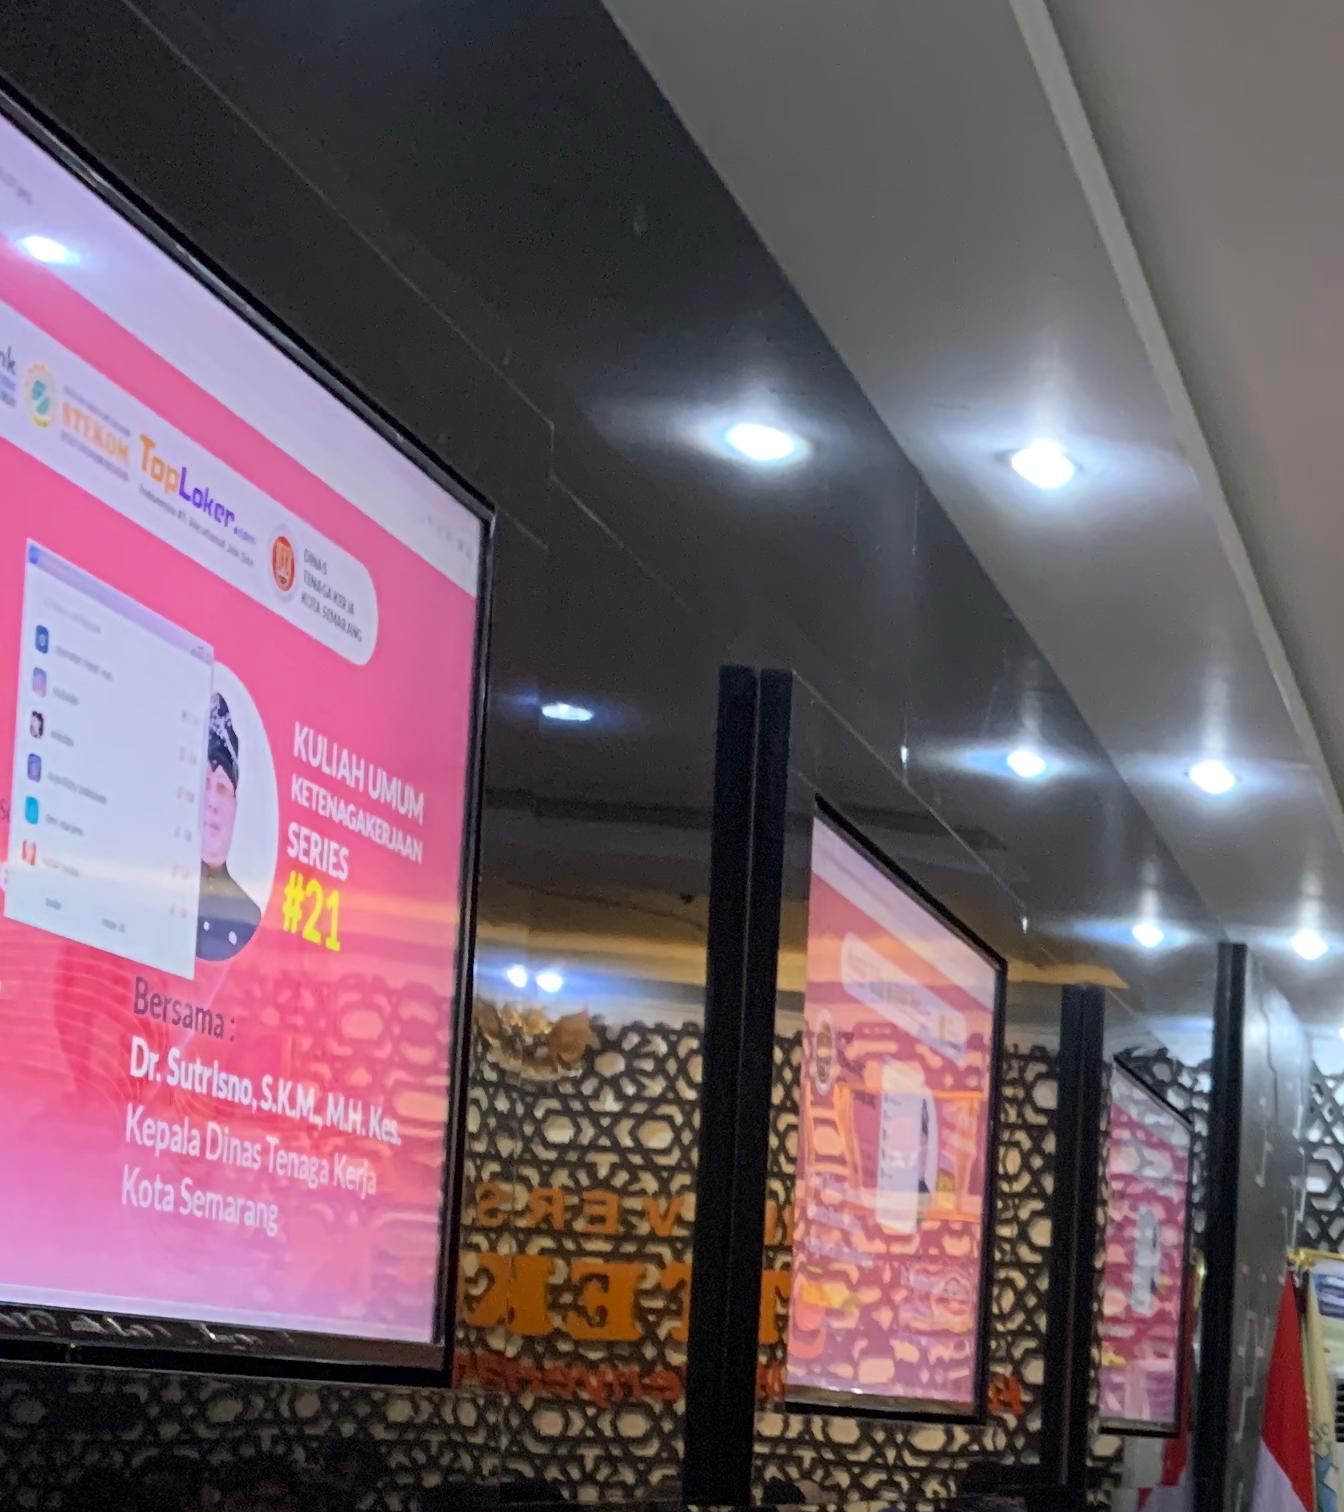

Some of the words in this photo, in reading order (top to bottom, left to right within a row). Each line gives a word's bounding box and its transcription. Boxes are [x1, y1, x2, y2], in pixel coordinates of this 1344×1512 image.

[293, 721, 365, 793] KULIAH
[368, 763, 424, 825] UMUM
[287, 821, 350, 882] SERIES
[291, 773, 424, 865] KETENAGAKERJAAN
[282, 870, 342, 953] #21
[133, 976, 225, 1040] Bersama
[129, 1035, 162, 1082] Dr.
[166, 1047, 257, 1114] Sutrisno,
[125, 1102, 200, 1157] Kepala
[205, 1121, 261, 1172] Dinas
[266, 1135, 329, 1190] Tenaga
[333, 1152, 377, 1200] Kerja
[121, 1164, 175, 1212] Kota
[180, 1176, 279, 1237] Semarang
